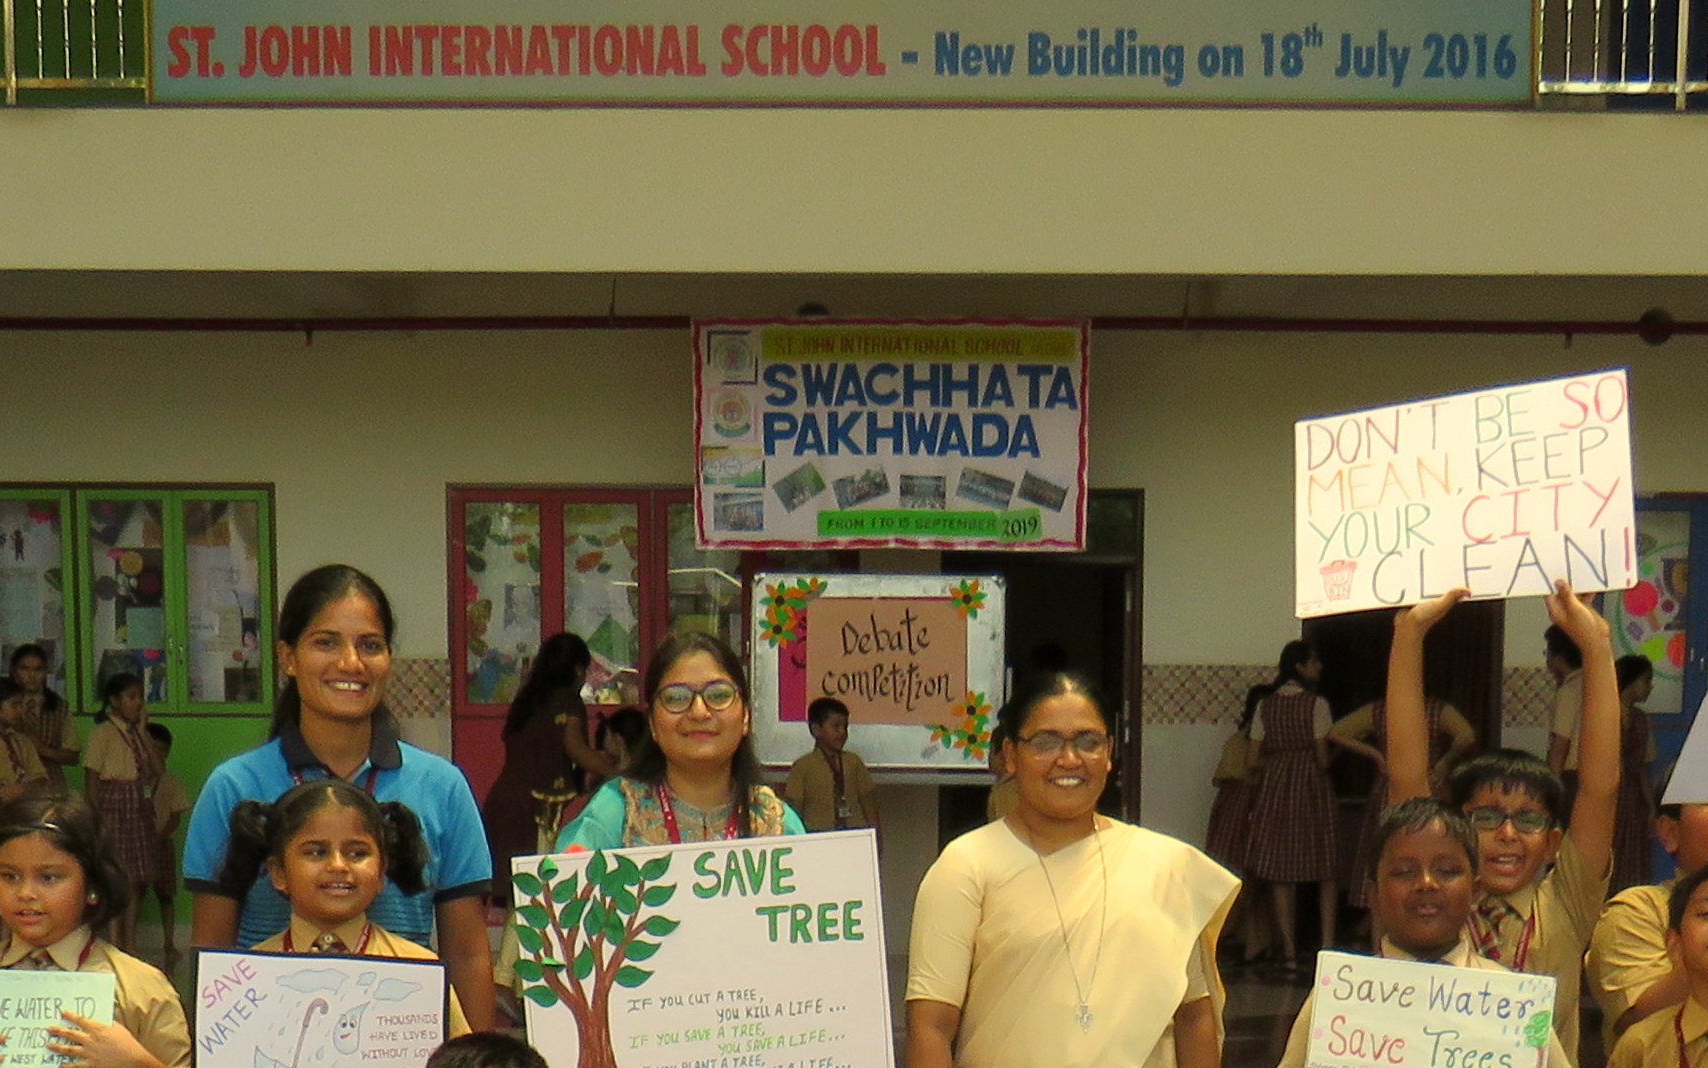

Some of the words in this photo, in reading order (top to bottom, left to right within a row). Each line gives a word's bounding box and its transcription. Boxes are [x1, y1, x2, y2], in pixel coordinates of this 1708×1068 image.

[167, 26, 224, 78] ST.
[239, 26, 352, 78] JOHN
[369, 24, 706, 77] INTERNATIONAL
[721, 24, 887, 77] SCHOOL
[934, 31, 1015, 77] New
[1027, 29, 1185, 87] Building
[1197, 40, 1244, 77] on
[1260, 23, 1324, 77] 18th
[1334, 30, 1411, 87] July
[1422, 33, 1518, 78] 2016
[763, 362, 1078, 411] SWACHHATA
[763, 411, 1041, 458] PAKHWADA
[1305, 400, 1451, 472] DON'T
[1474, 390, 1535, 444] BE
[1558, 375, 1627, 430] SO
[1475, 426, 1609, 491] KEEP
[827, 518, 865, 530] FROM
[915, 518, 997, 530] SEPTEMBER
[1001, 515, 1039, 538] 2019
[1307, 502, 1435, 563] YOUR
[1461, 475, 1621, 544] CITY
[841, 607, 932, 658] Debate
[692, 846, 797, 899] SAVE
[755, 900, 866, 944] TREE
[201, 958, 258, 1010] SAVE
[627, 997, 653, 1013] IF
[659, 995, 684, 1010] YOU
[687, 992, 711, 1007] CUT
[716, 990, 726, 1001] A
[1333, 963, 1417, 1009] Save
[1428, 975, 1535, 1020] Water
[14, 996, 65, 1021] WATER
[74, 996, 97, 1019] TO
[198, 987, 268, 1055] WATER
[376, 1014, 440, 1027] THOUSANDS
[715, 1007, 740, 1023] YOU
[745, 1005, 772, 1020] KILL
[774, 1005, 784, 1016] A
[360, 1048, 409, 1062] WITHOUT
[413, 1046, 439, 1060] LOV
[369, 1031, 398, 1042] HAVE
[402, 1030, 439, 1042] LIVED
[628, 1034, 649, 1050] IF
[656, 1031, 680, 1046] YOU
[684, 1028, 712, 1043] SAVE
[717, 1025, 726, 1038] A
[718, 1042, 741, 1056] YOU
[746, 1037, 773, 1051] SAVE
[777, 1035, 786, 1046] A
[1328, 1014, 1406, 1065] Save
